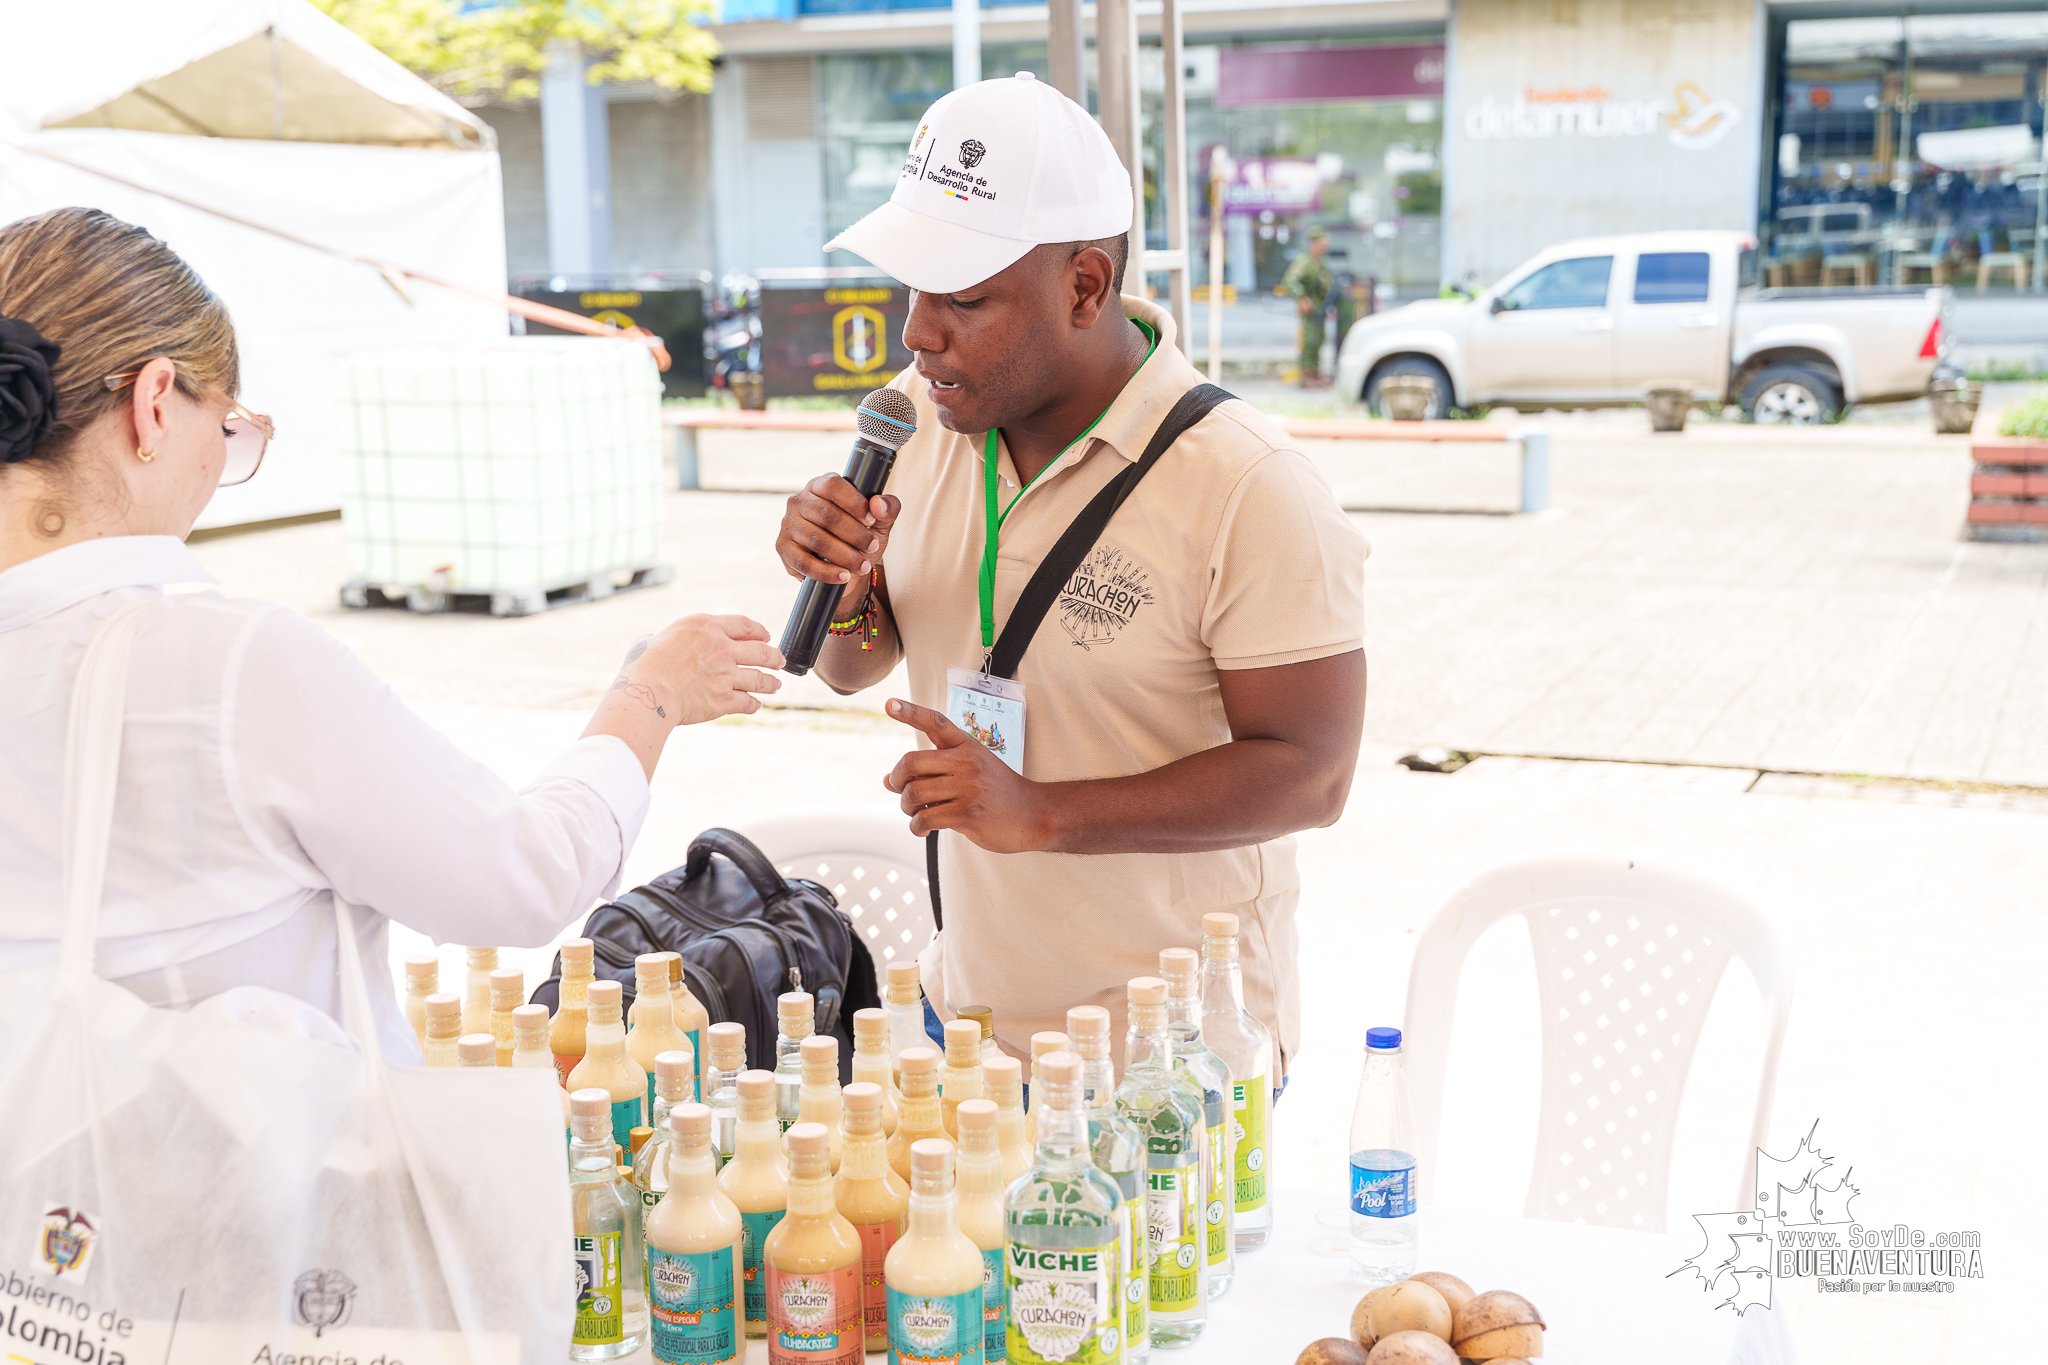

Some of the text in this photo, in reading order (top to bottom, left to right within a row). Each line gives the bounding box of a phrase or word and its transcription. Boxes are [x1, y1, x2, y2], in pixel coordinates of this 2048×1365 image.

[927, 171, 997, 201] Desarrollo Rural
[940, 164, 988, 187] Agencia de
[1061, 575, 1141, 618] URACHON
[1360, 1191, 1387, 1208] Pool
[1011, 1247, 1098, 1272] VICHE
[653, 1267, 690, 1286] CURACHON
[784, 1294, 828, 1307] CURACHON
[99, 1307, 134, 1338] de
[667, 1323, 683, 1332] Coco
[904, 1315, 950, 1328] CURACHON
[1021, 1307, 1087, 1328] CURACHON
[0, 1305, 127, 1365] lombia
[783, 1336, 833, 1350] TUMBACATRE
